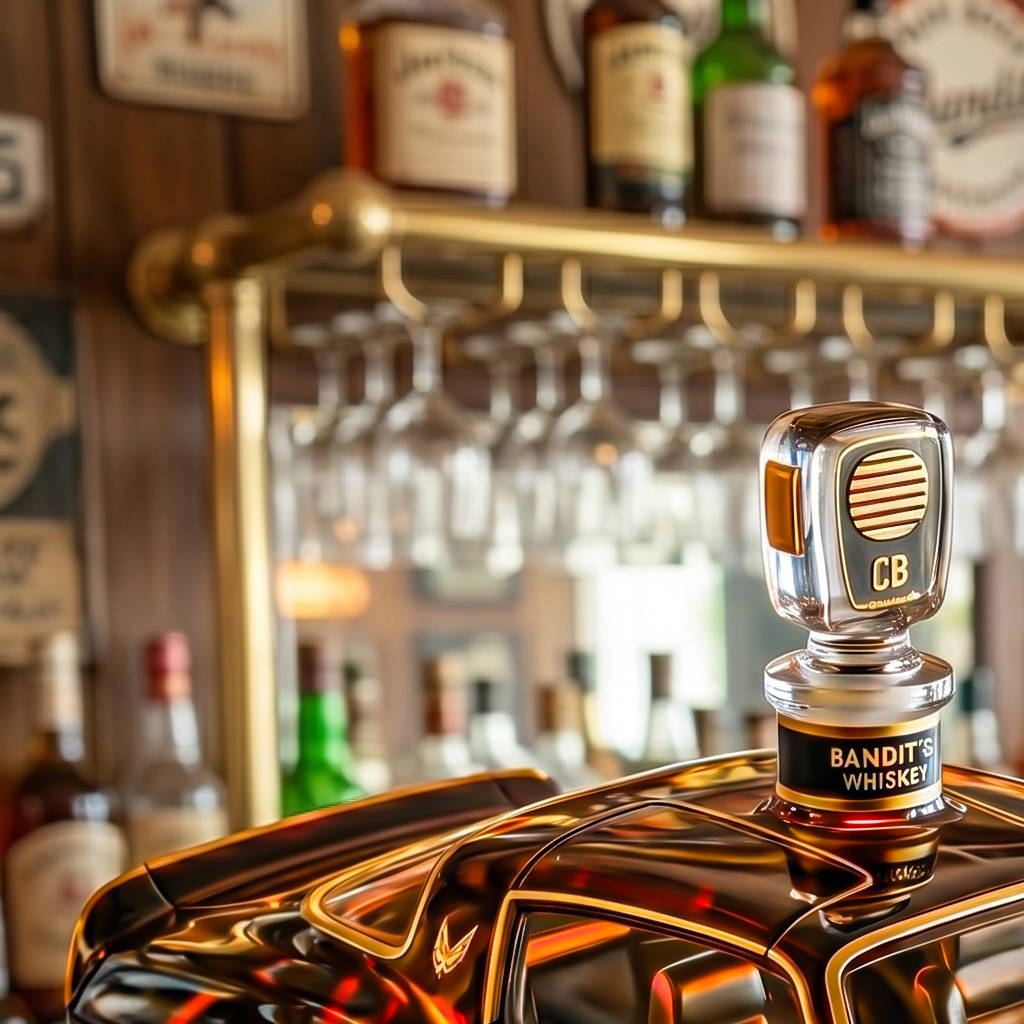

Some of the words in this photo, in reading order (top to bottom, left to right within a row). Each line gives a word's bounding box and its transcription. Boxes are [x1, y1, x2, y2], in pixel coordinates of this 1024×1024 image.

[872, 554, 909, 592] CB
[829, 737, 934, 769] BANDIT'S
[842, 764, 928, 791] WHISKEY
